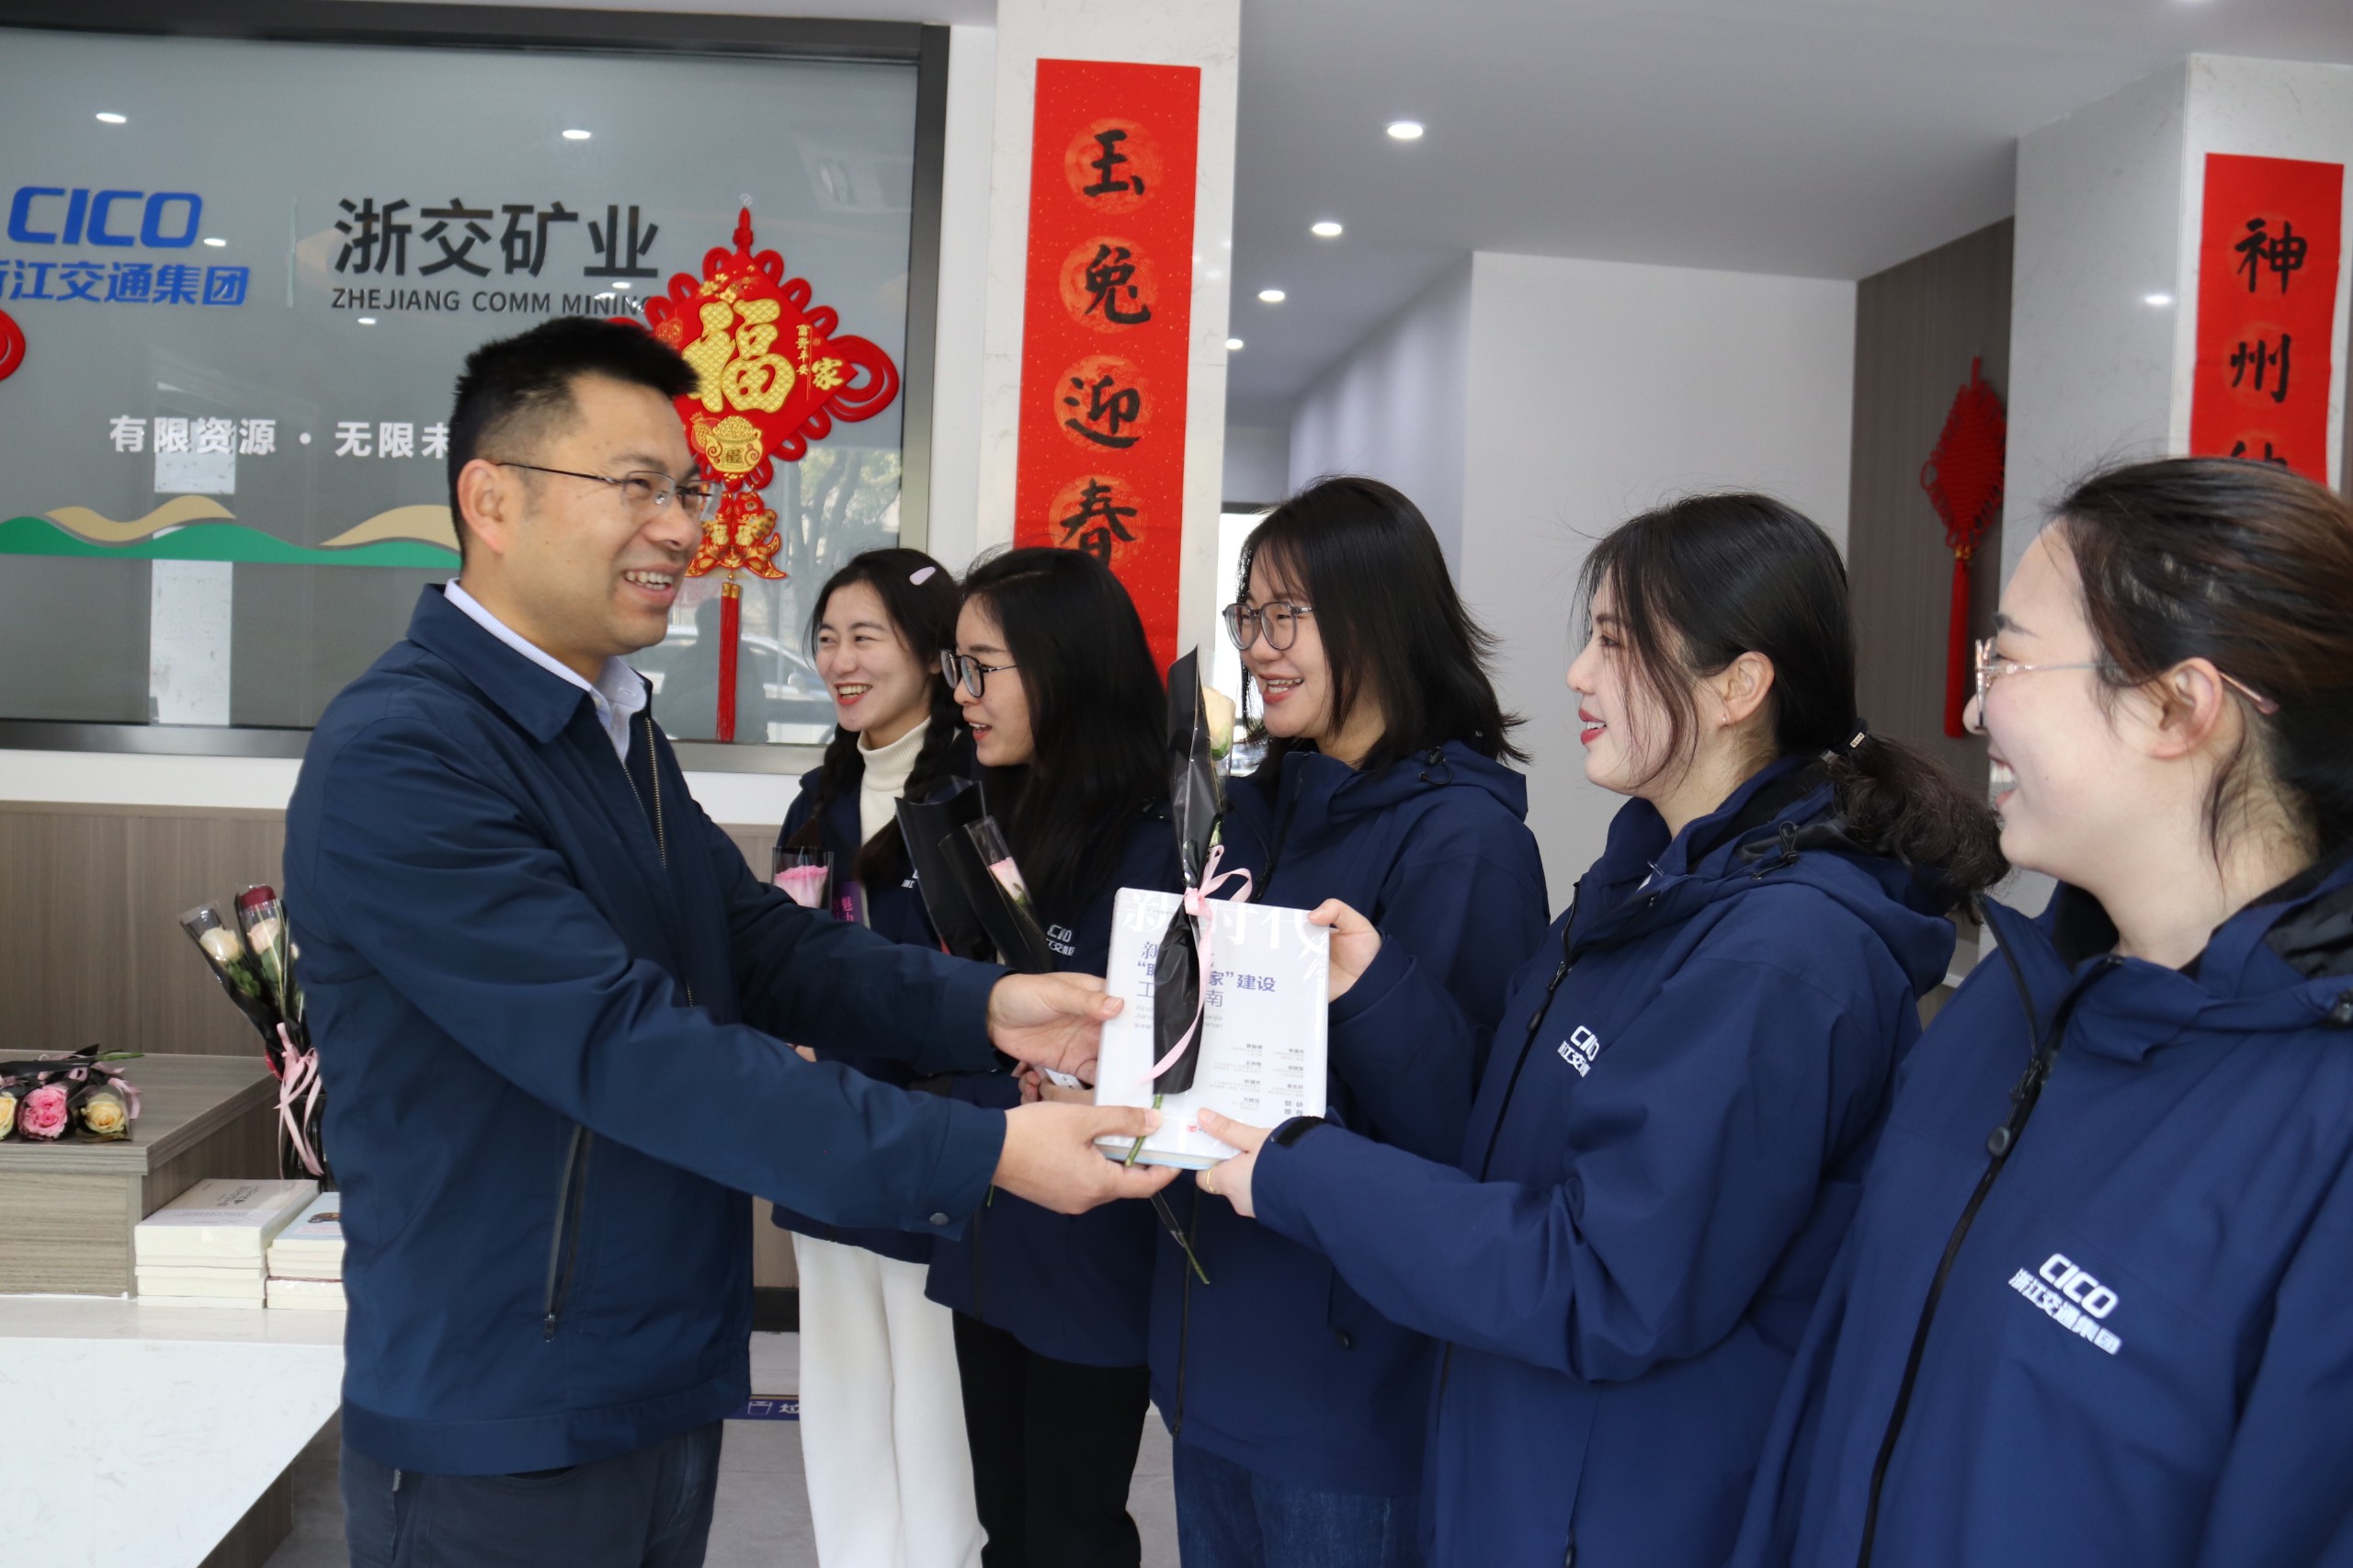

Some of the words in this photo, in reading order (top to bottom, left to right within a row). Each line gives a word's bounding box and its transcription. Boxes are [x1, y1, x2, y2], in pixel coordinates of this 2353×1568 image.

[6, 186, 203, 249] CICO
[333, 197, 660, 279] 浙交矿业
[0, 259, 250, 306] 江交通集团
[331, 287, 460, 312] ZHEJIANG
[472, 290, 551, 314] COMM
[562, 293, 651, 316] MININ
[681, 298, 796, 414] 福
[1059, 128, 1153, 567] 玉兔迎春
[2007, 1267, 2122, 1357] 浙江交通集团
[2038, 1252, 2120, 1320] CICO
